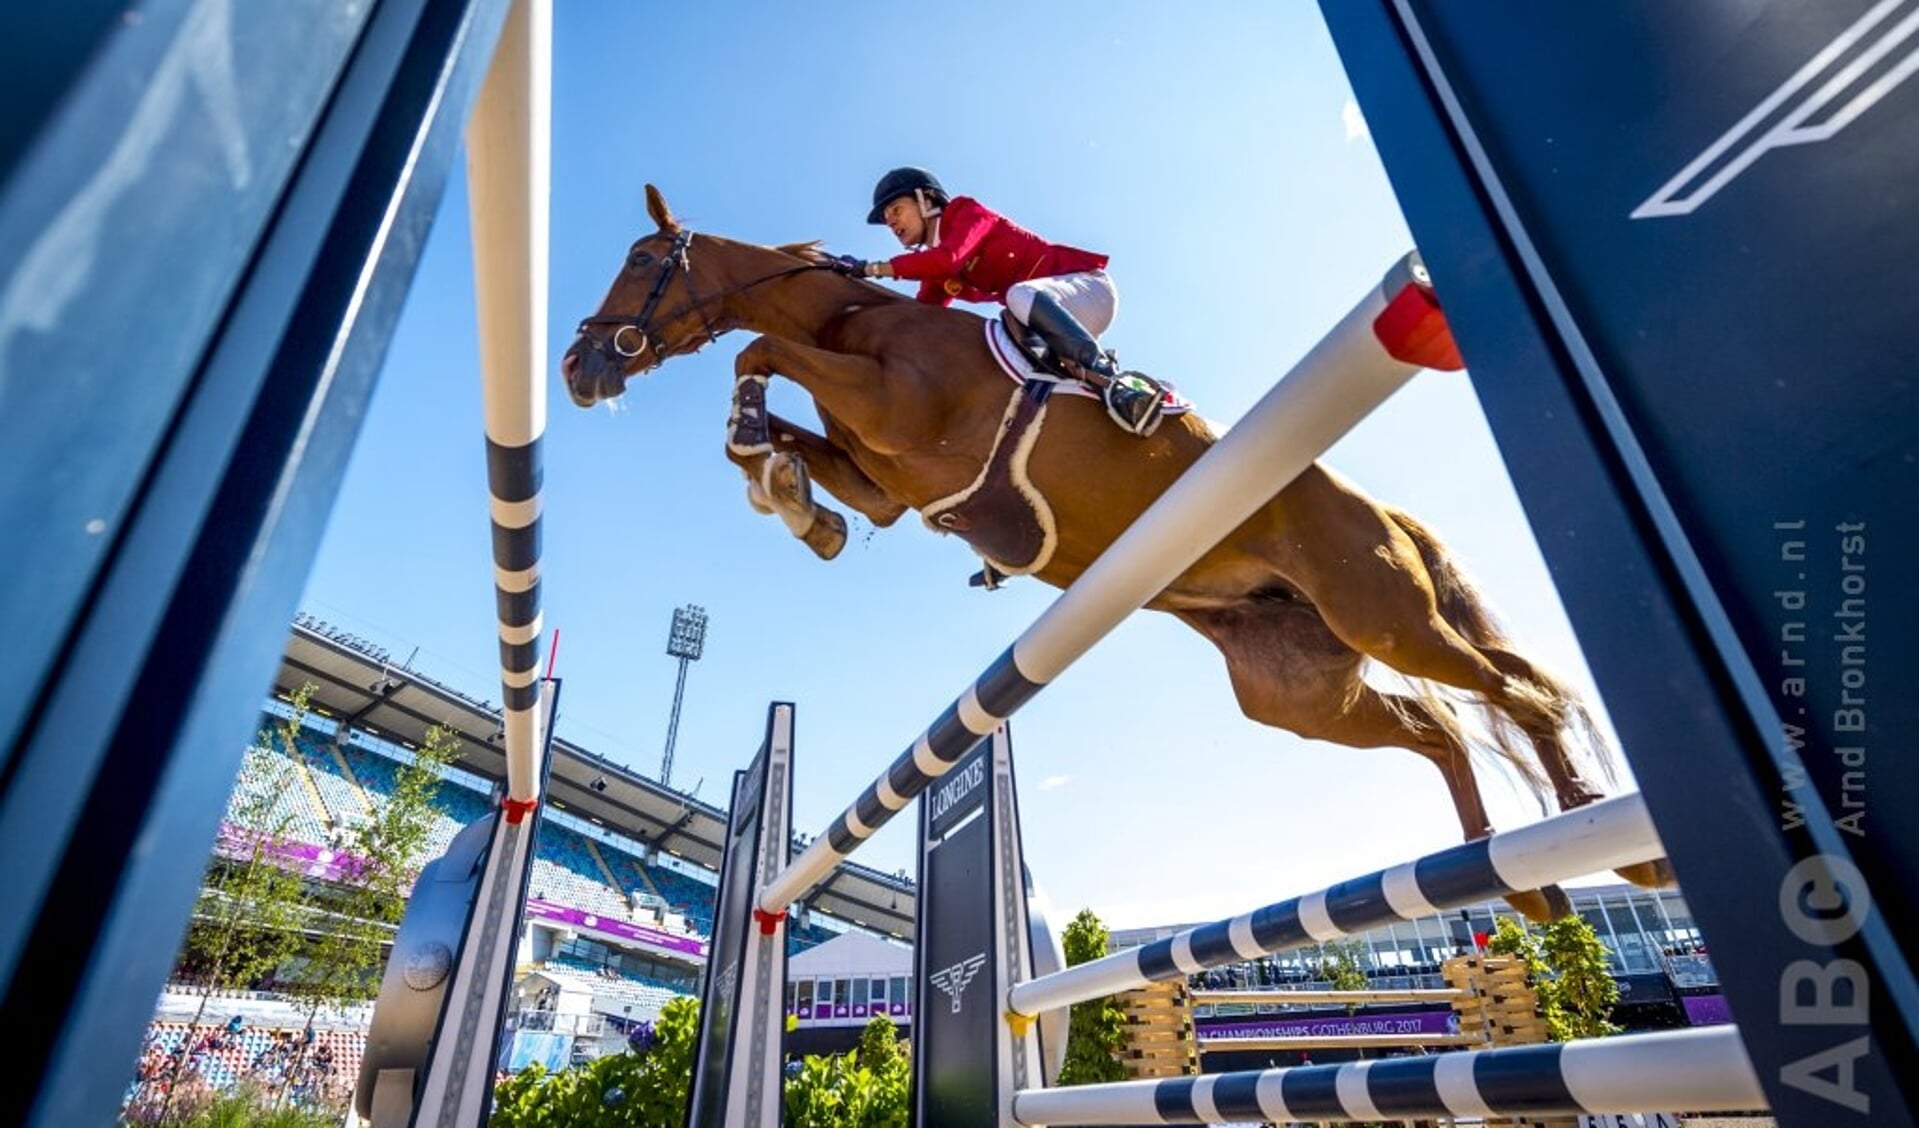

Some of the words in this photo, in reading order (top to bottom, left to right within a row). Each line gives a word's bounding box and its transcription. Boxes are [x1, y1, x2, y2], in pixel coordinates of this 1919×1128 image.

[1210, 1025, 1309, 1039] CHAMPIONSHIPS
[1311, 1020, 1395, 1036] GOTHENBURG
[1396, 1018, 1422, 1033] 2017
